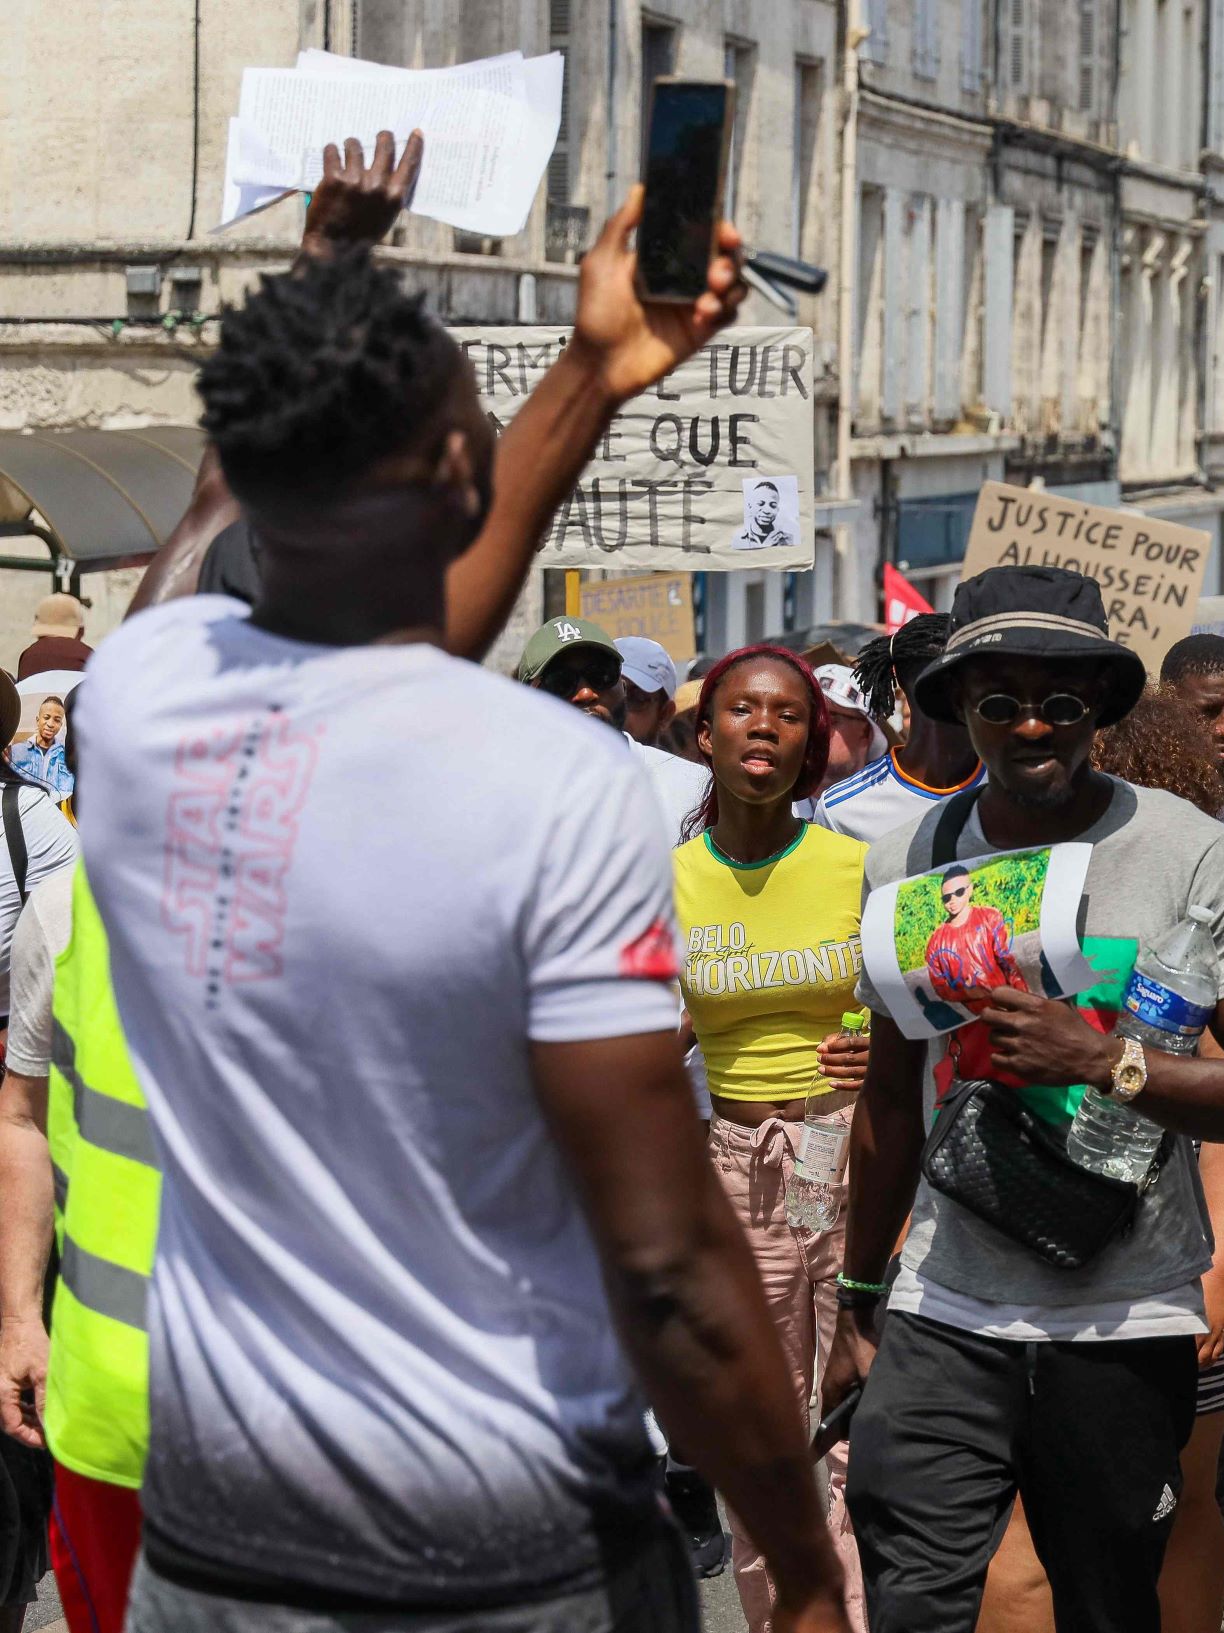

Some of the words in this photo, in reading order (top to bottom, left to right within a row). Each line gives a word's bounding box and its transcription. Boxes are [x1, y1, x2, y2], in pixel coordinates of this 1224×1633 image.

[702, 344, 808, 400] TUER
[651, 413, 760, 468] QUE
[988, 496, 1124, 549] JUSTICE
[1131, 532, 1199, 573] POUR
[554, 621, 582, 642] LA
[688, 922, 746, 953] BELO
[685, 937, 862, 995] HORIZONTE
[1136, 982, 1164, 1004] Saguaro
